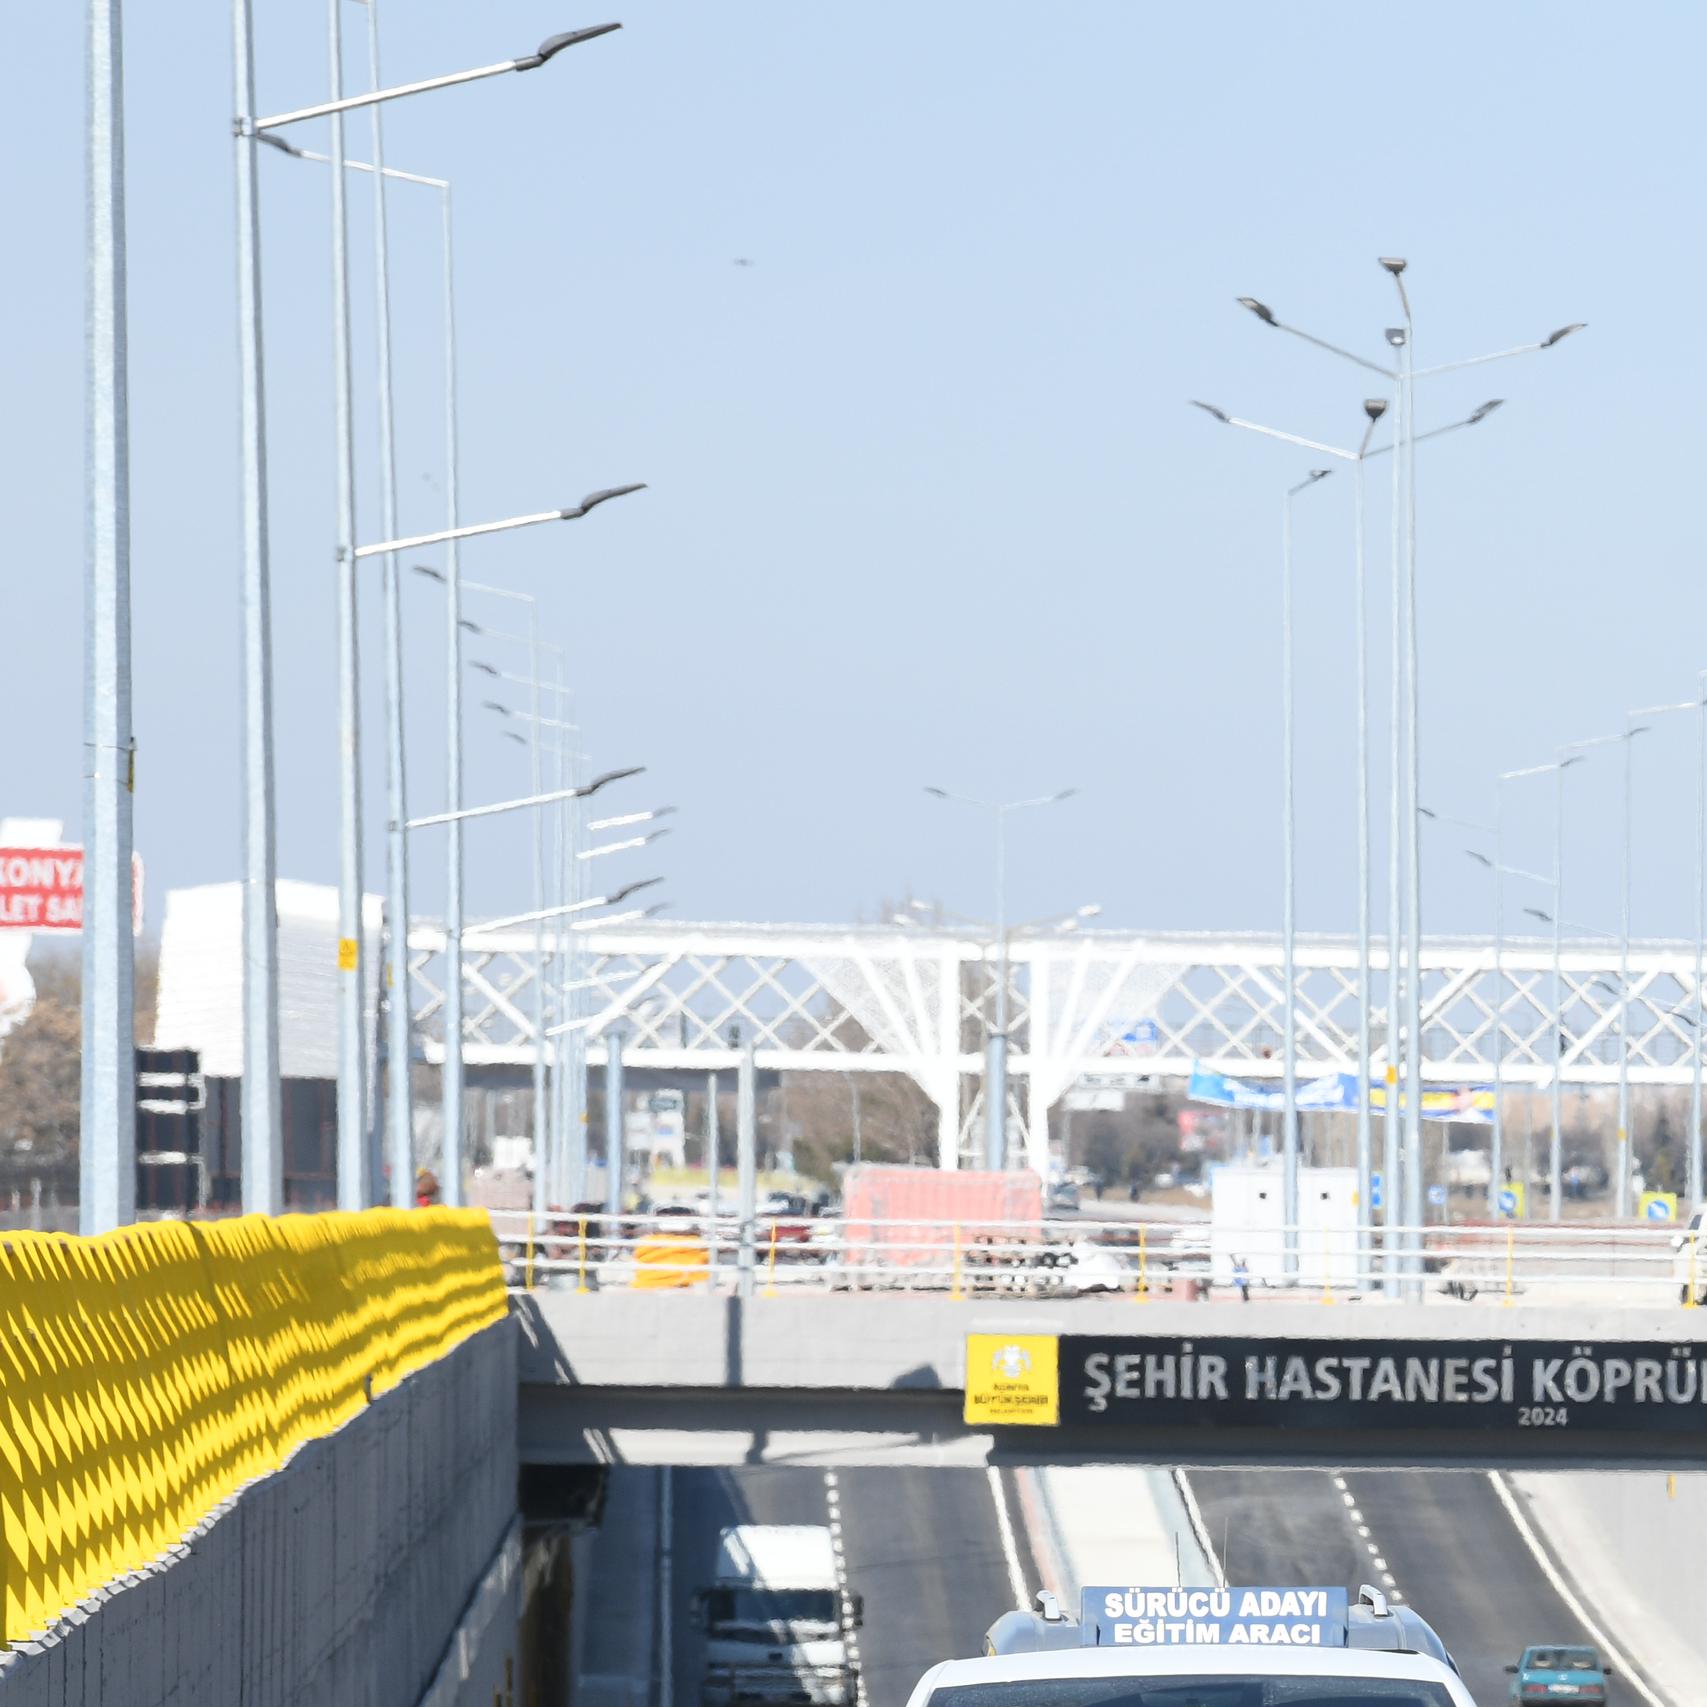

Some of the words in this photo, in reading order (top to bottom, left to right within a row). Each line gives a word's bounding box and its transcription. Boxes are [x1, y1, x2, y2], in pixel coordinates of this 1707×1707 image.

[1084, 1341, 1228, 1412] ŞEHİR
[1245, 1345, 1515, 1402] HASTANESİ
[1518, 1408, 1568, 1427] 2024
[1104, 1588, 1230, 1618] SÜRÜCÜ
[1238, 1591, 1327, 1617] ADAYI
[1113, 1618, 1220, 1644] EĞİTİM
[1228, 1623, 1321, 1644] ARACI
